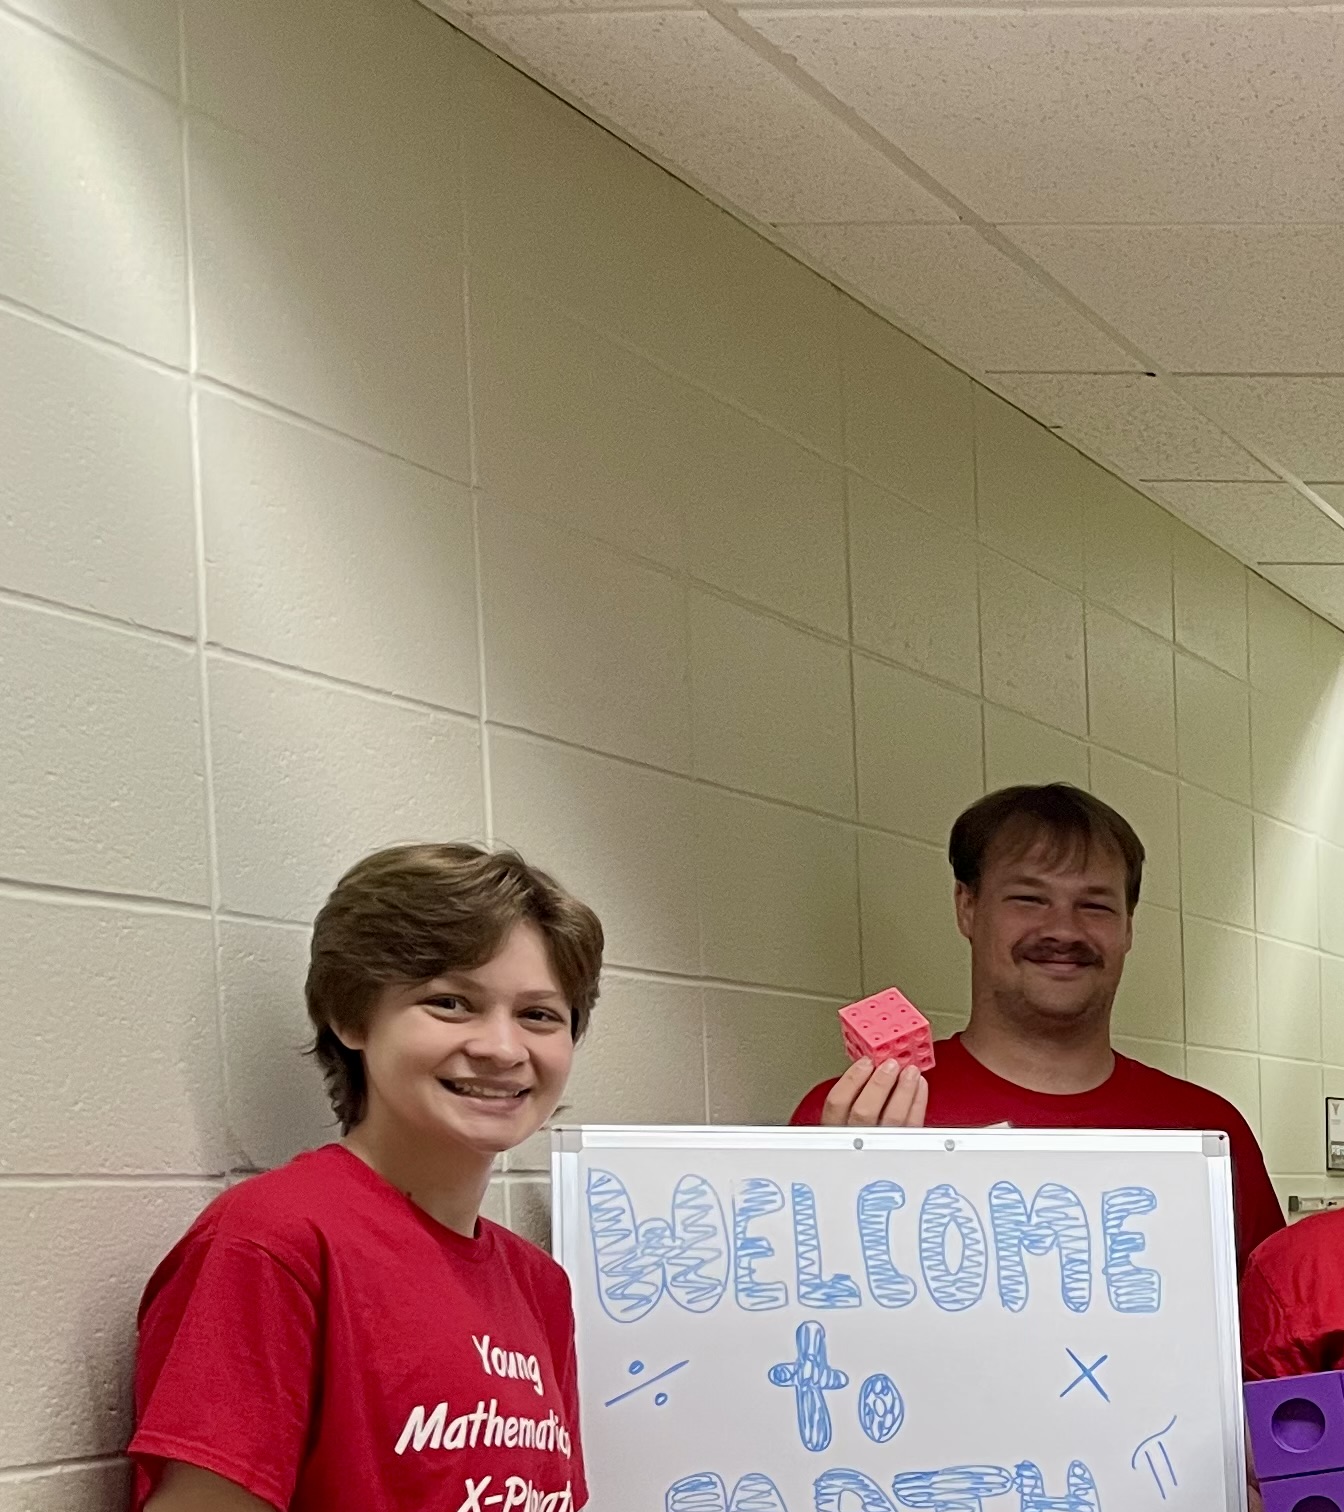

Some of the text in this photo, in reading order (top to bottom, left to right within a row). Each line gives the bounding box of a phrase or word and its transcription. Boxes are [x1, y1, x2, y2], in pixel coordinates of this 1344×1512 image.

[586, 1167, 1162, 1323] WELCOME
[471, 1335, 544, 1396] Young
[767, 1320, 904, 1452] to
